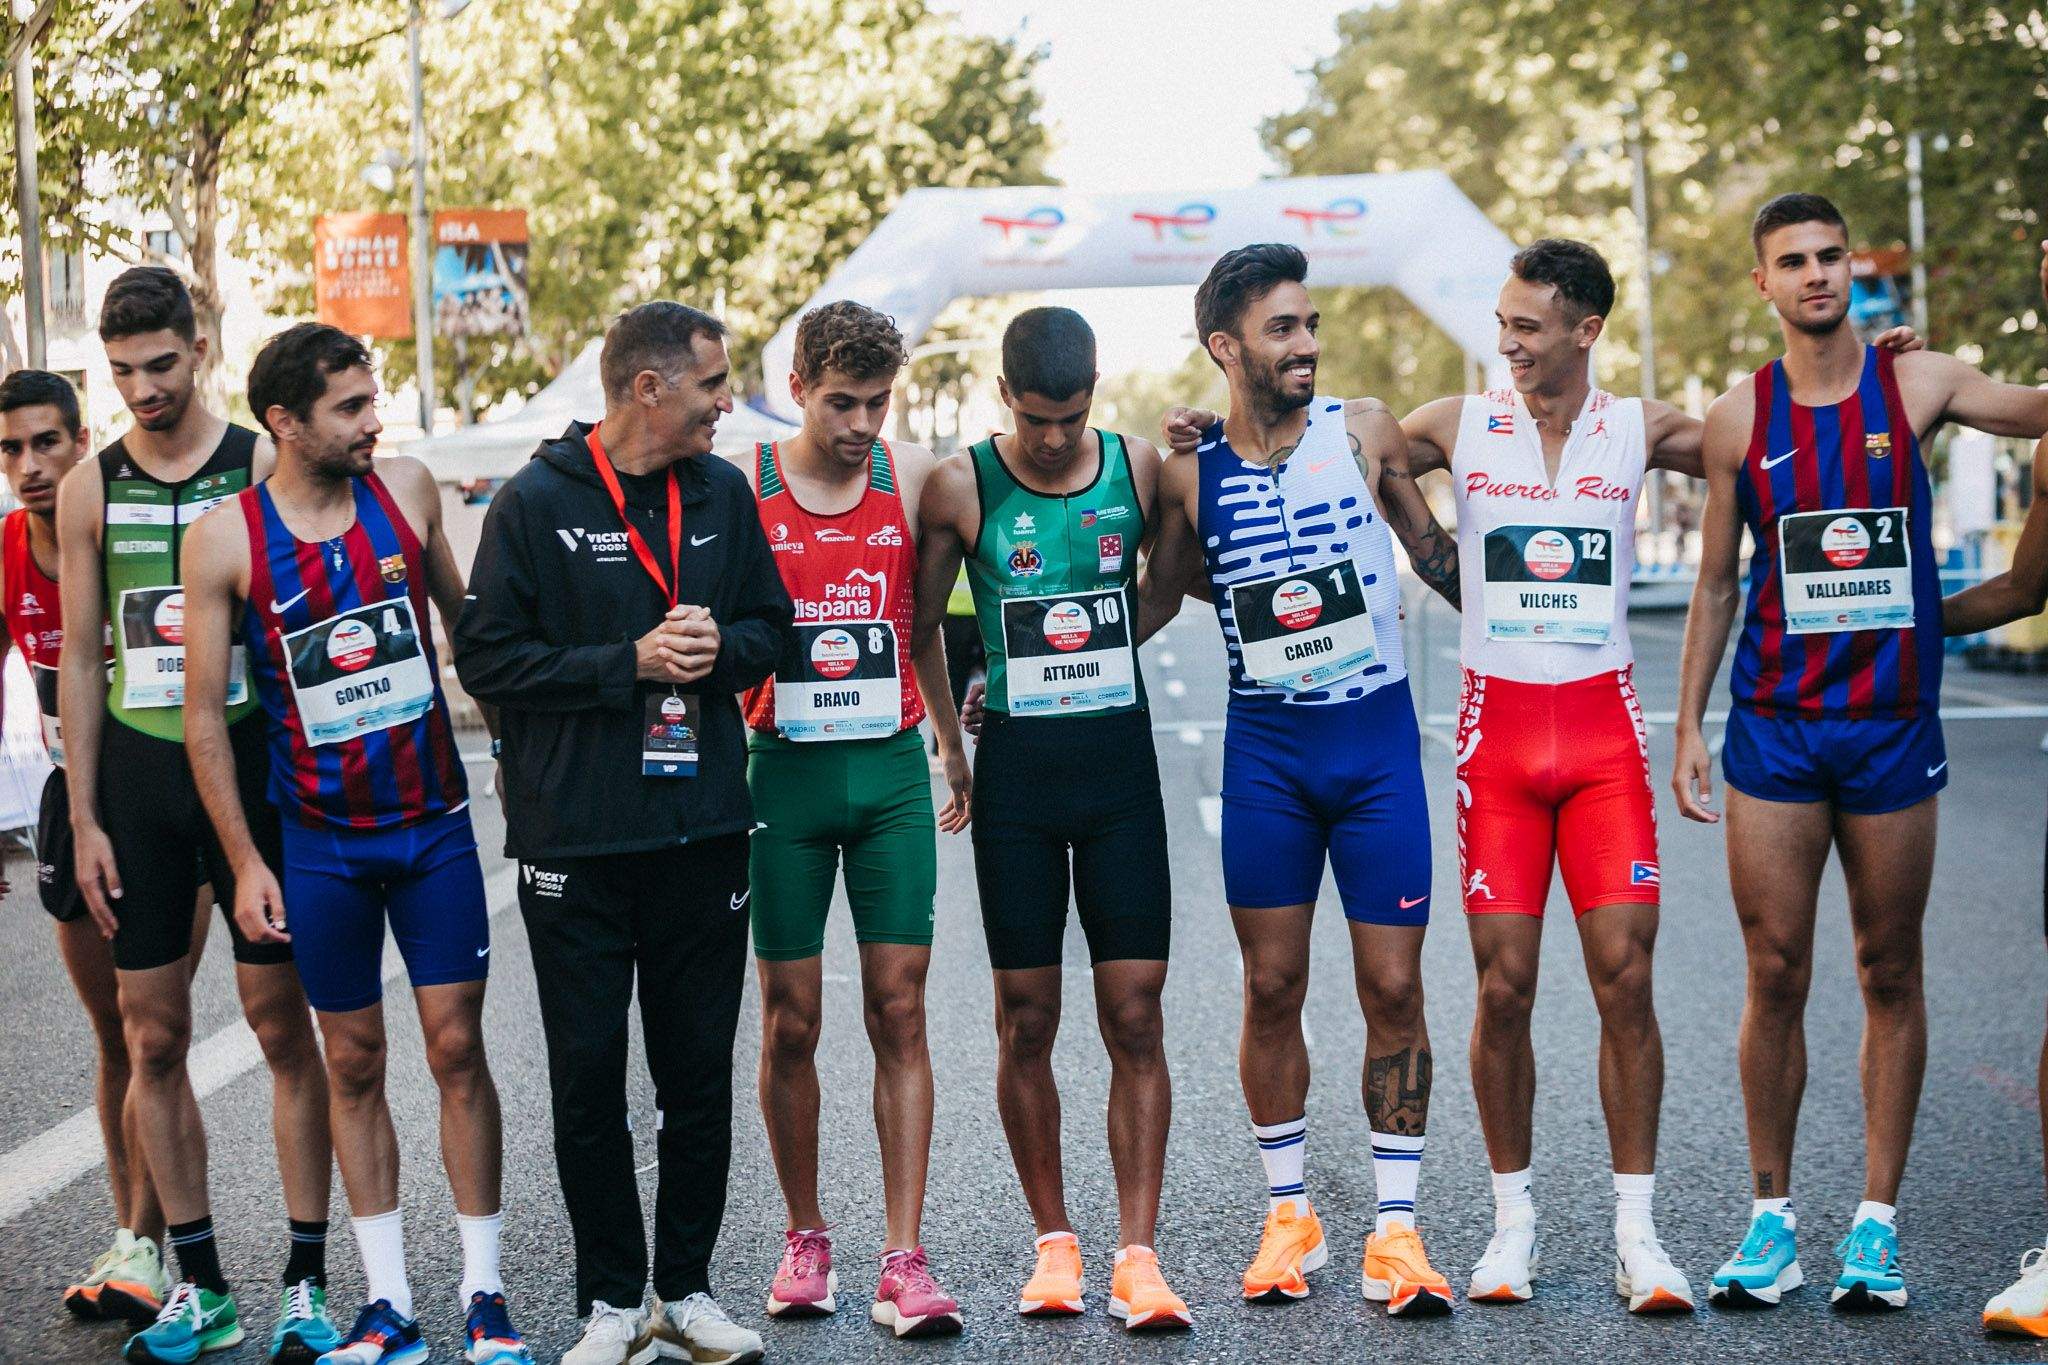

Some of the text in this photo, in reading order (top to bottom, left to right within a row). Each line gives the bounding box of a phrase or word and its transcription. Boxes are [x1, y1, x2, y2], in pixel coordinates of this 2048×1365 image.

[1466, 472, 1559, 500] Puerto
[1574, 475, 1631, 503] Rico
[586, 532, 629, 543] VICKY
[1875, 515, 1893, 544] 2
[592, 543, 628, 552] FOODS
[1578, 532, 1606, 560] 12
[825, 583, 871, 599] Patria
[1328, 568, 1347, 596] 1
[1805, 580, 1892, 599] VALLADARES
[1093, 597, 1120, 625] 10
[1519, 593, 1578, 609] VILCHES
[383, 608, 402, 636] 4
[868, 627, 884, 654] 8
[1284, 636, 1334, 661] CARRO
[1043, 661, 1101, 682] ATTAOUI
[335, 677, 391, 705] GONTXO
[813, 691, 860, 708] BRAVO
[1023, 699, 1053, 707] MADRID
[788, 725, 816, 733] MADRID
[663, 764, 678, 773] VIP
[534, 871, 568, 883] VICKY
